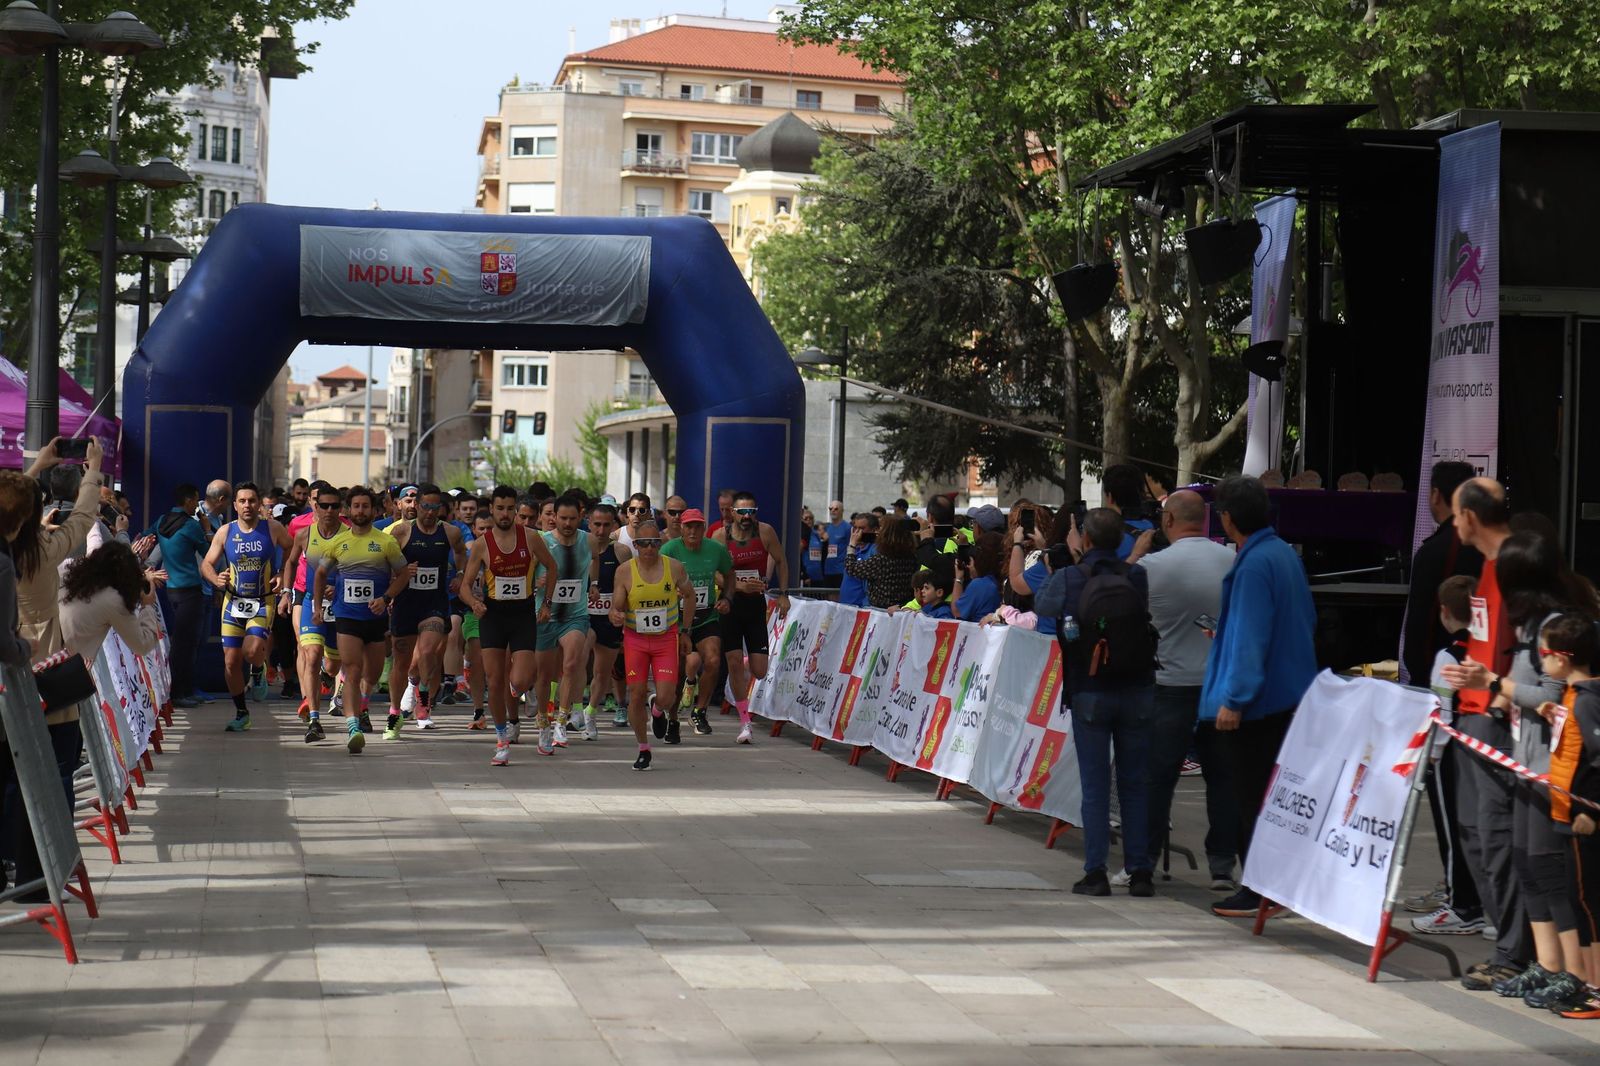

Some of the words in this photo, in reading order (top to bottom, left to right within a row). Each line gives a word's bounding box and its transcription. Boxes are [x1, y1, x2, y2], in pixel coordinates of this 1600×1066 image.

[349, 248, 388, 260] NOS
[348, 263, 452, 287] IMPULSA
[522, 279, 576, 297] Junta
[580, 280, 605, 297] de
[467, 298, 534, 314] Castilla
[541, 303, 552, 317] y
[556, 300, 604, 315] León
[234, 541, 263, 554] JESUS
[412, 573, 437, 585] 105
[346, 586, 372, 598] 156
[502, 584, 520, 595] 25
[558, 586, 576, 598] 37
[238, 601, 253, 613] 92
[588, 600, 611, 610] 260
[639, 599, 670, 608] TEAM
[643, 615, 661, 627] 18
[1273, 785, 1318, 820] VALORES
[1351, 844, 1364, 868] y
